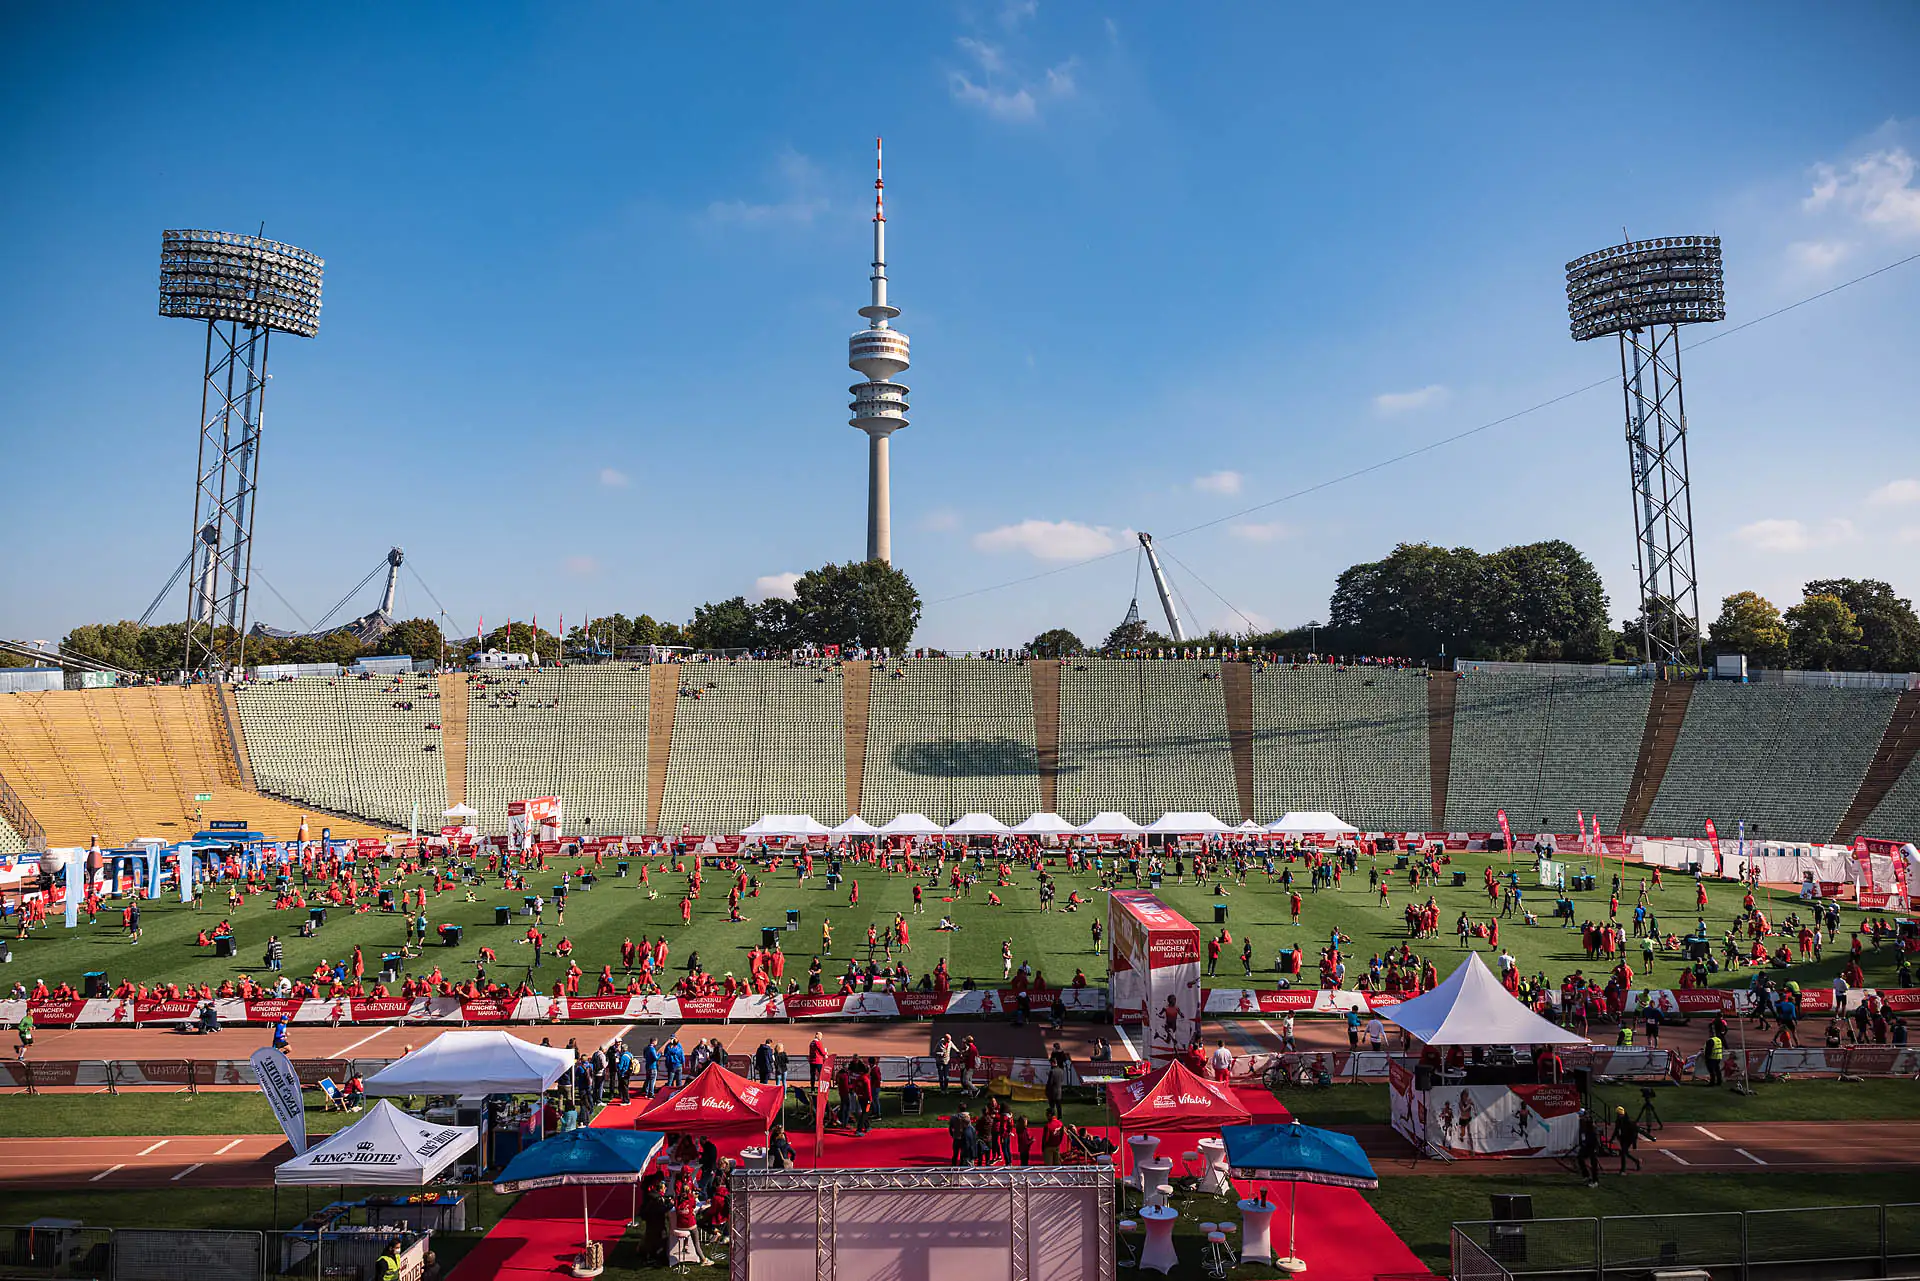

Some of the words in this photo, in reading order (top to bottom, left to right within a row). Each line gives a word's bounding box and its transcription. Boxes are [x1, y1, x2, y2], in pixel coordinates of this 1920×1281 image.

[1163, 951, 1199, 959] MARATHON
[800, 999, 841, 1008] GENERALI
[1272, 995, 1312, 1004] GENERALI
[1690, 995, 1721, 1003] GENERA
[150, 1003, 191, 1012] GENERALI
[366, 1002, 407, 1011] GENERALI
[582, 1001, 624, 1010] GENERALI
[1722, 999, 1733, 1009] VIP
[819, 1080, 830, 1093] VIP
[701, 1096, 735, 1112] Vitality
[1178, 1092, 1212, 1107] Vitality
